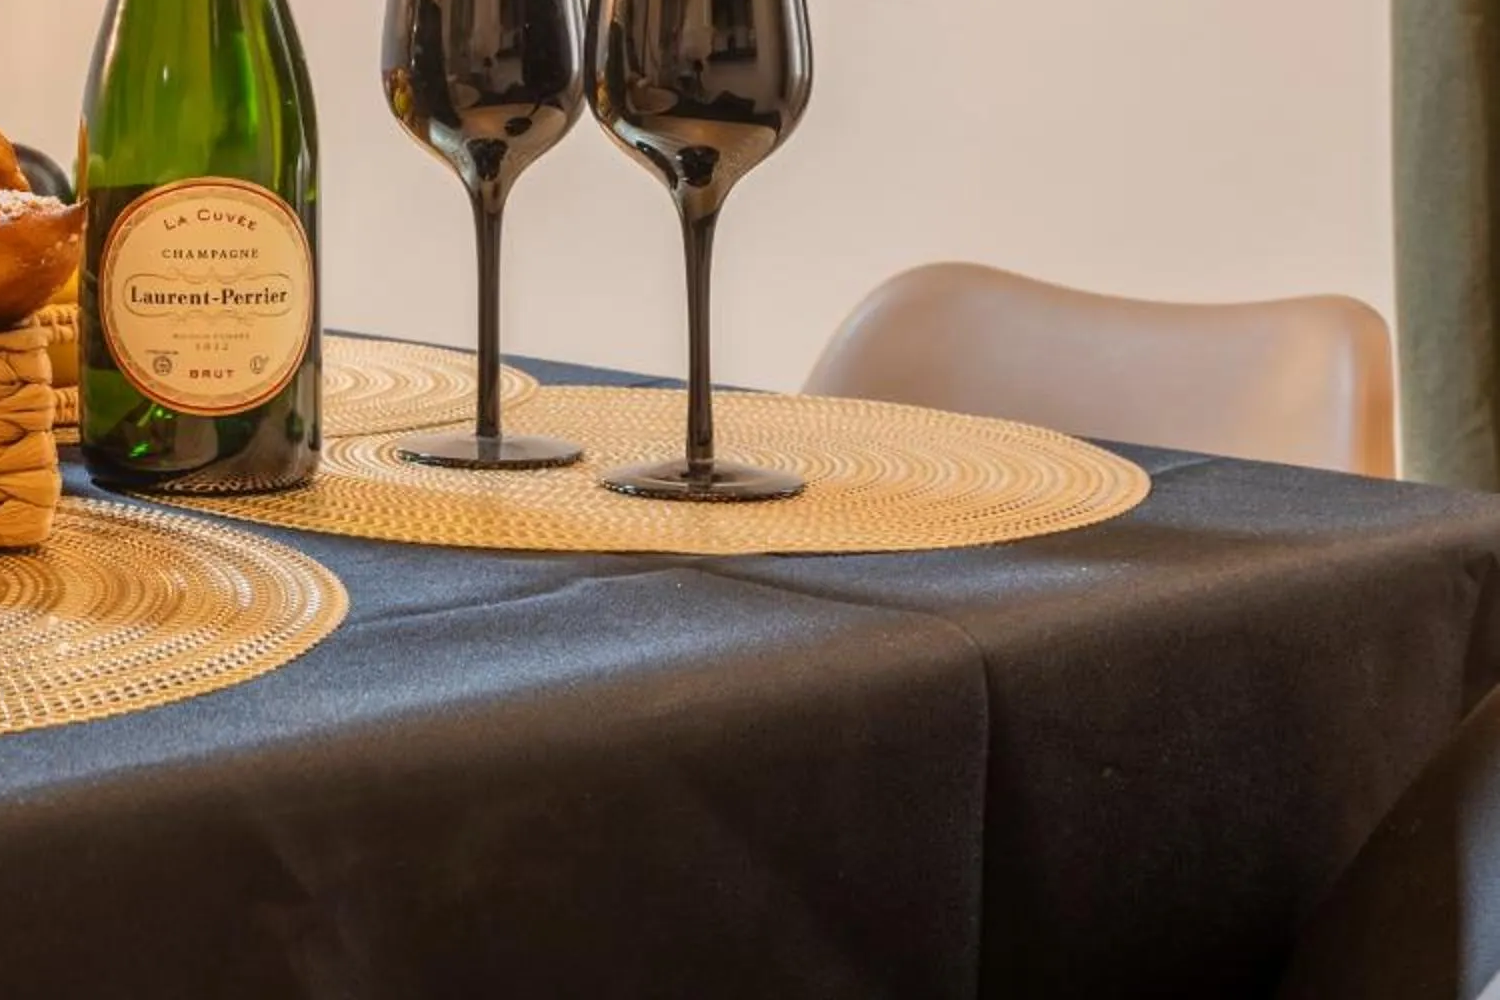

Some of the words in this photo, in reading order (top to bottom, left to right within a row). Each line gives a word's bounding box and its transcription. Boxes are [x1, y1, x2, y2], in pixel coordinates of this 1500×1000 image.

[162, 248, 259, 259] CHAMPAGNE
[131, 286, 288, 306] Laurent-Perrier
[189, 369, 235, 379] BRUT
